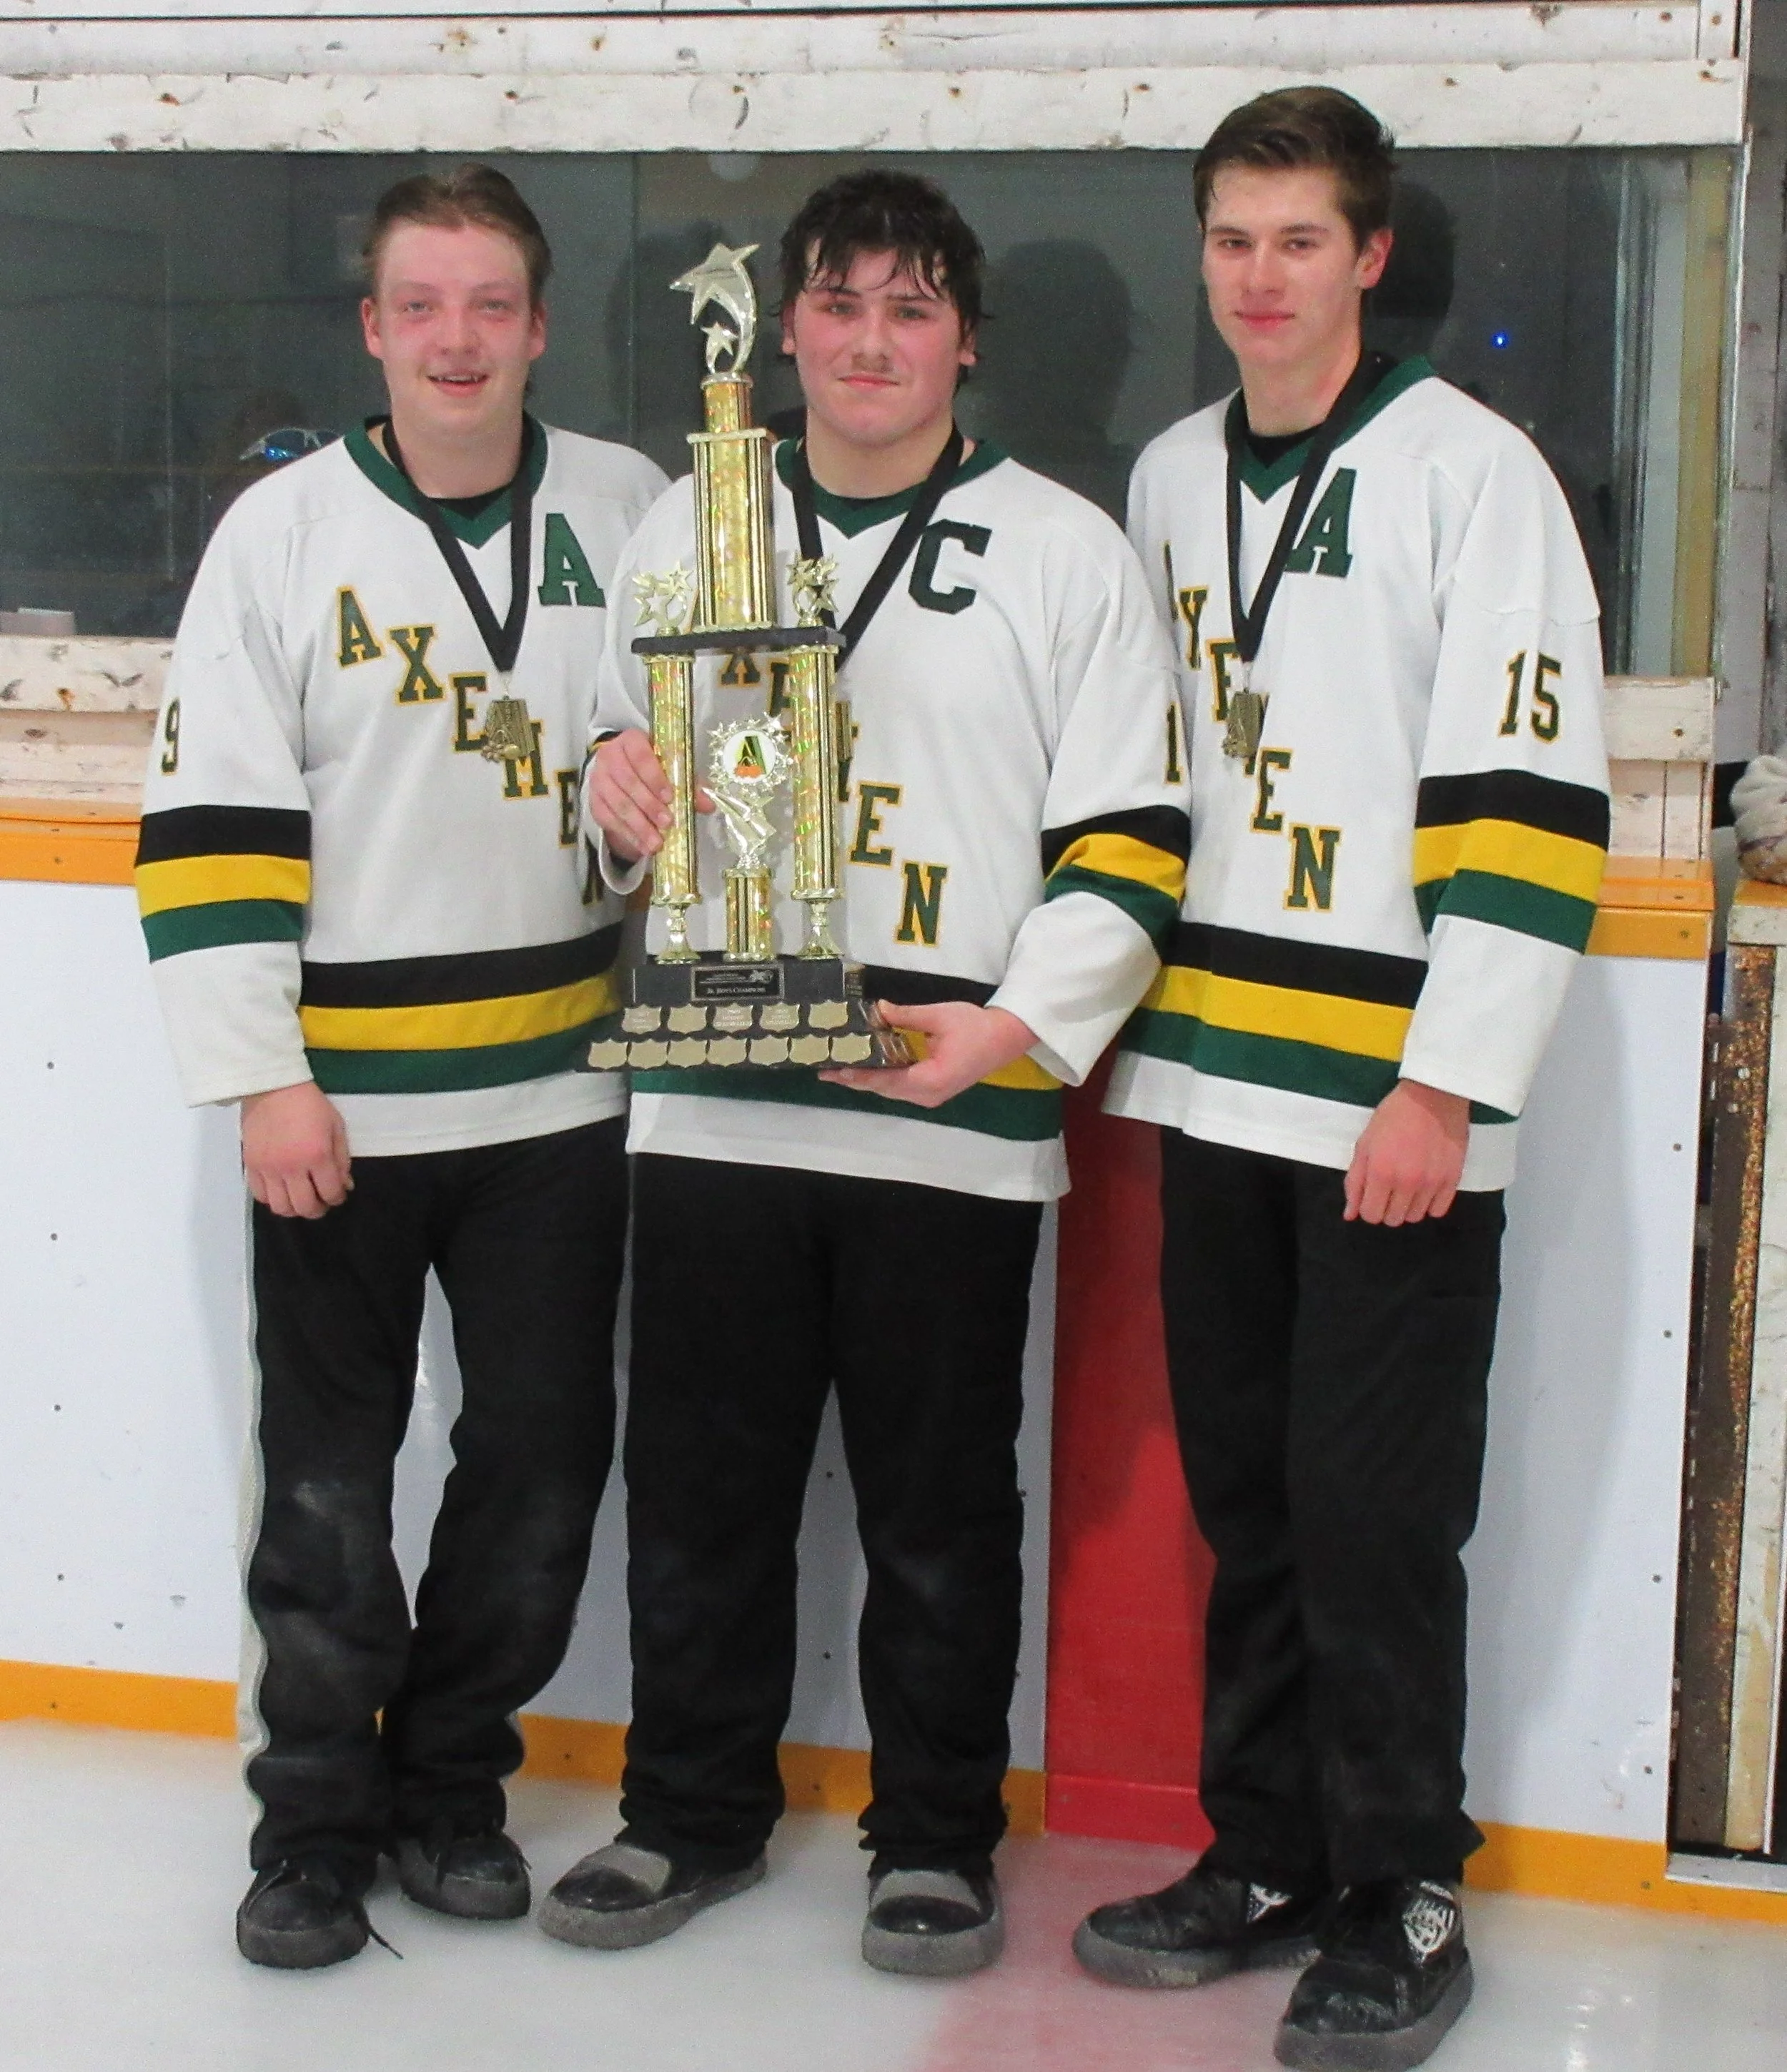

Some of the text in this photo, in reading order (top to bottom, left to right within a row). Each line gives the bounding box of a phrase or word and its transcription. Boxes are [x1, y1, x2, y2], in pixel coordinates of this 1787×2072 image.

[537, 513, 607, 608] A
[908, 518, 994, 616] C
[1284, 466, 1357, 578] A
[1497, 649, 1564, 744] 15
